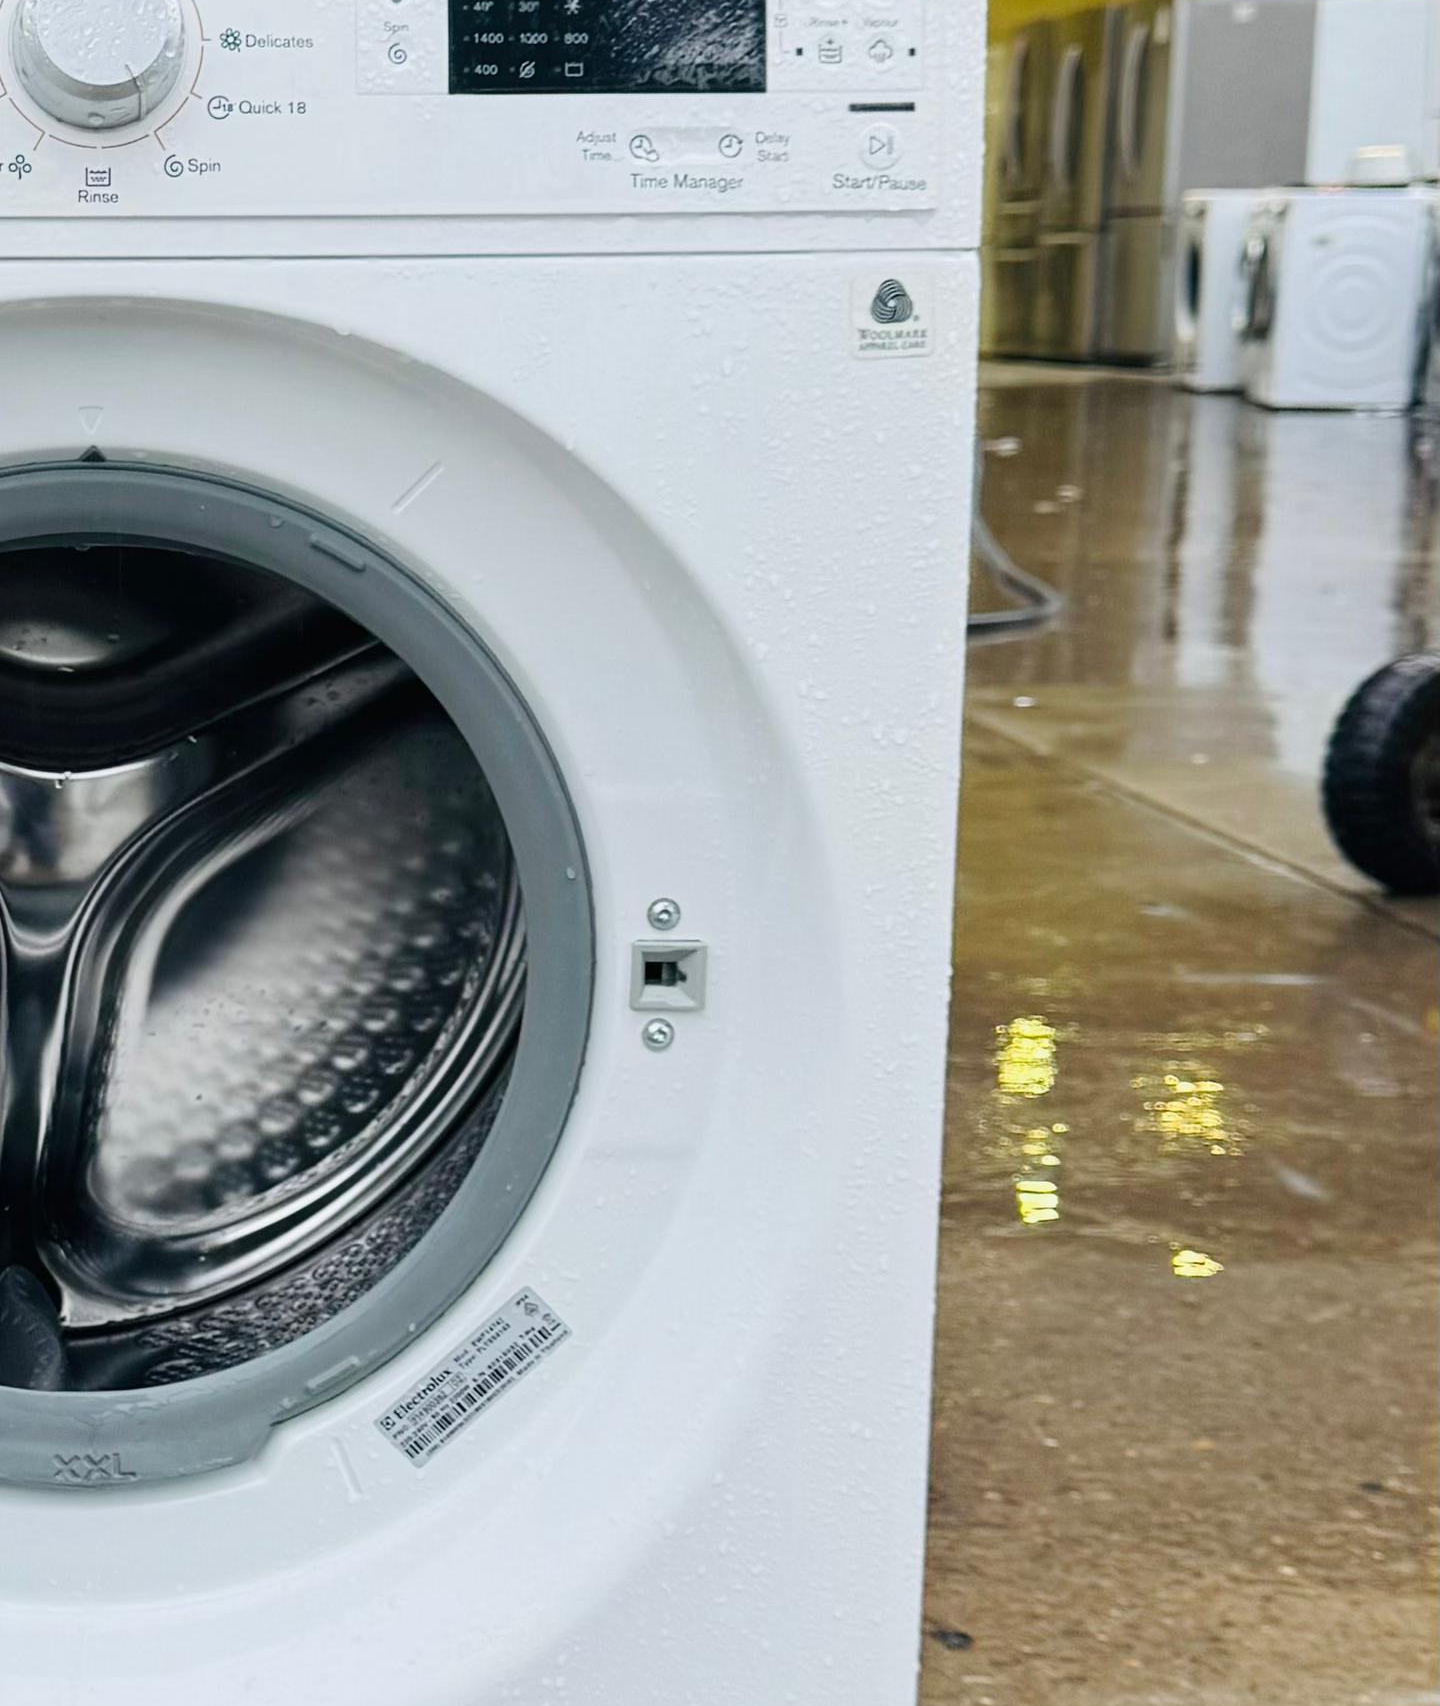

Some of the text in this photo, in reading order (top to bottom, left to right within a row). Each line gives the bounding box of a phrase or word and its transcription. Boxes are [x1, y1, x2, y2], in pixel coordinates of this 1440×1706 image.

[383, 20, 409, 34] Spin
[245, 34, 314, 48] Delicates
[474, 33, 504, 44] 1400
[564, 33, 589, 44] 800
[474, 64, 499, 75] 400
[238, 100, 307, 115] Quick 18
[577, 131, 617, 146] Adjust
[755, 131, 791, 146] Delay
[582, 149, 611, 161] Time
[757, 150, 790, 162] Start
[187, 159, 221, 175] Spin
[630, 173, 744, 193] Time Manager
[832, 173, 928, 191] Start/Pause
[77, 189, 119, 204] Rinse
[858, 328, 928, 340] WOOLMARK
[393, 1365, 453, 1419] Electrolux
[53, 1452, 137, 1479] XXL
